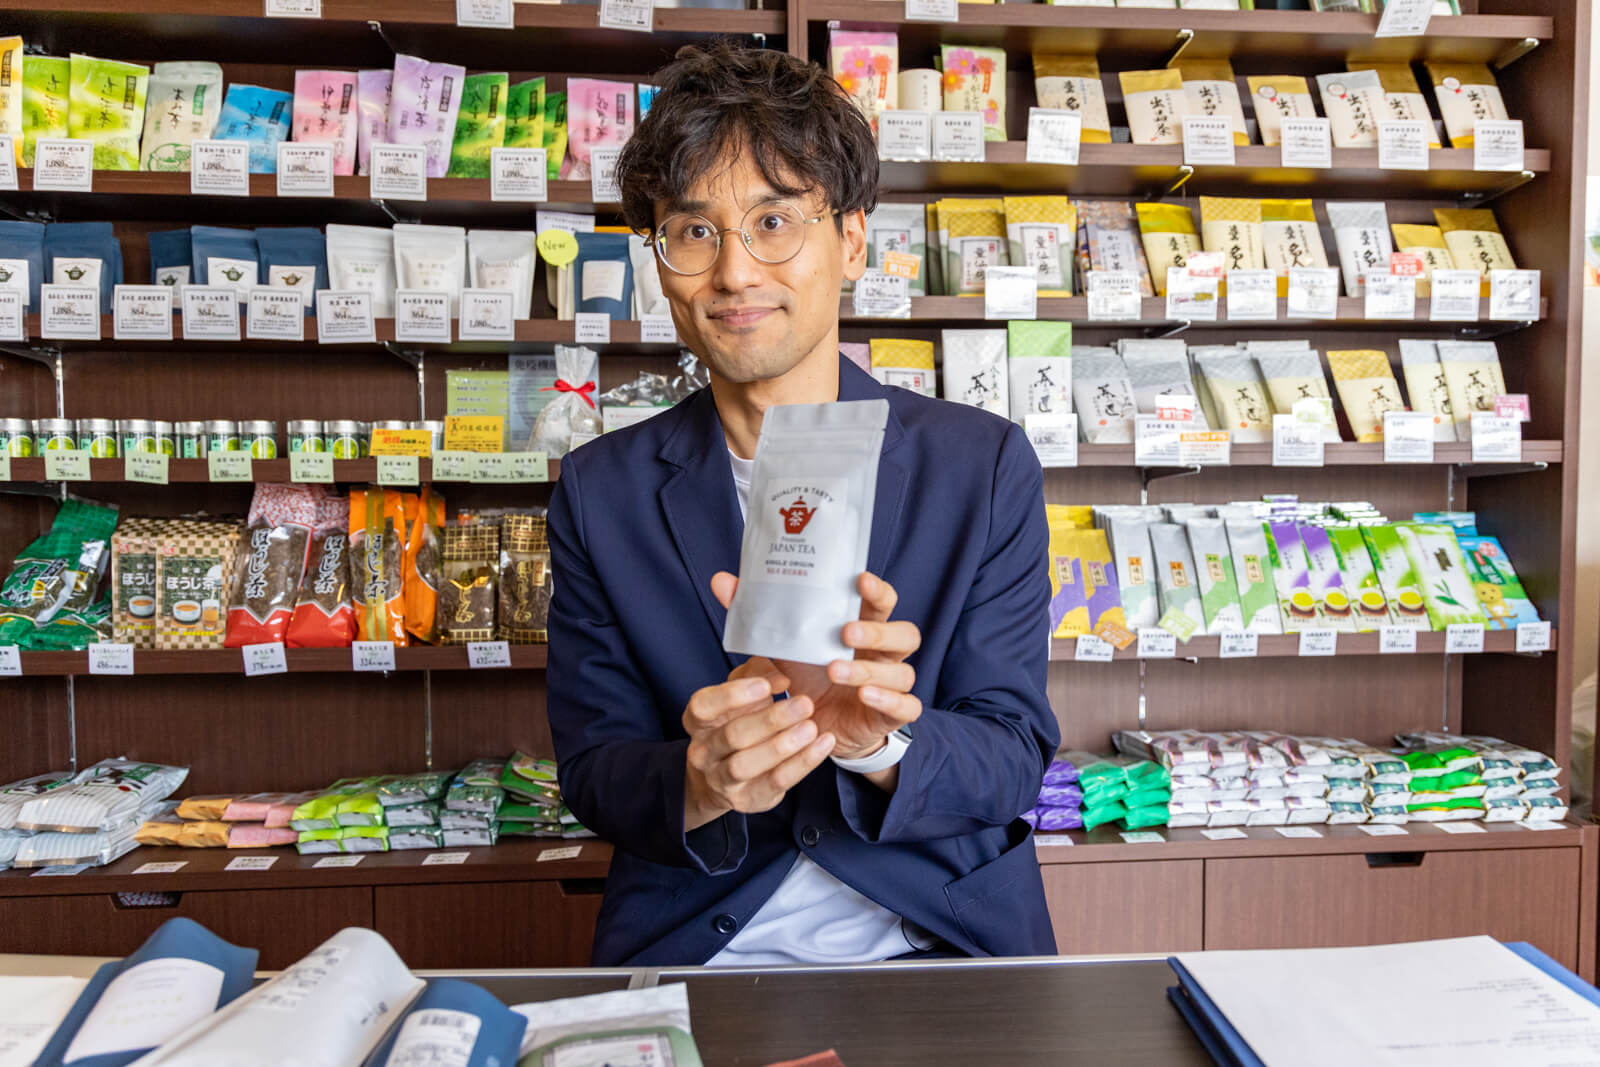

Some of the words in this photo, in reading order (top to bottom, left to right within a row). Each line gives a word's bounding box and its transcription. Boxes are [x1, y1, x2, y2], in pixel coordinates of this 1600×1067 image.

[543, 240, 567, 251] New
[771, 486, 802, 502] QUALITY
[810, 487, 834, 502] TASTY
[788, 510, 804, 527] 茶
[768, 543, 795, 555] JAPAN
[797, 543, 816, 555] TEA
[245, 528, 271, 598] ほうじ茶
[314, 535, 346, 595] ほうじ茶
[364, 533, 389, 599] ほうじ茶
[166, 576, 217, 591] ほうじ茶
